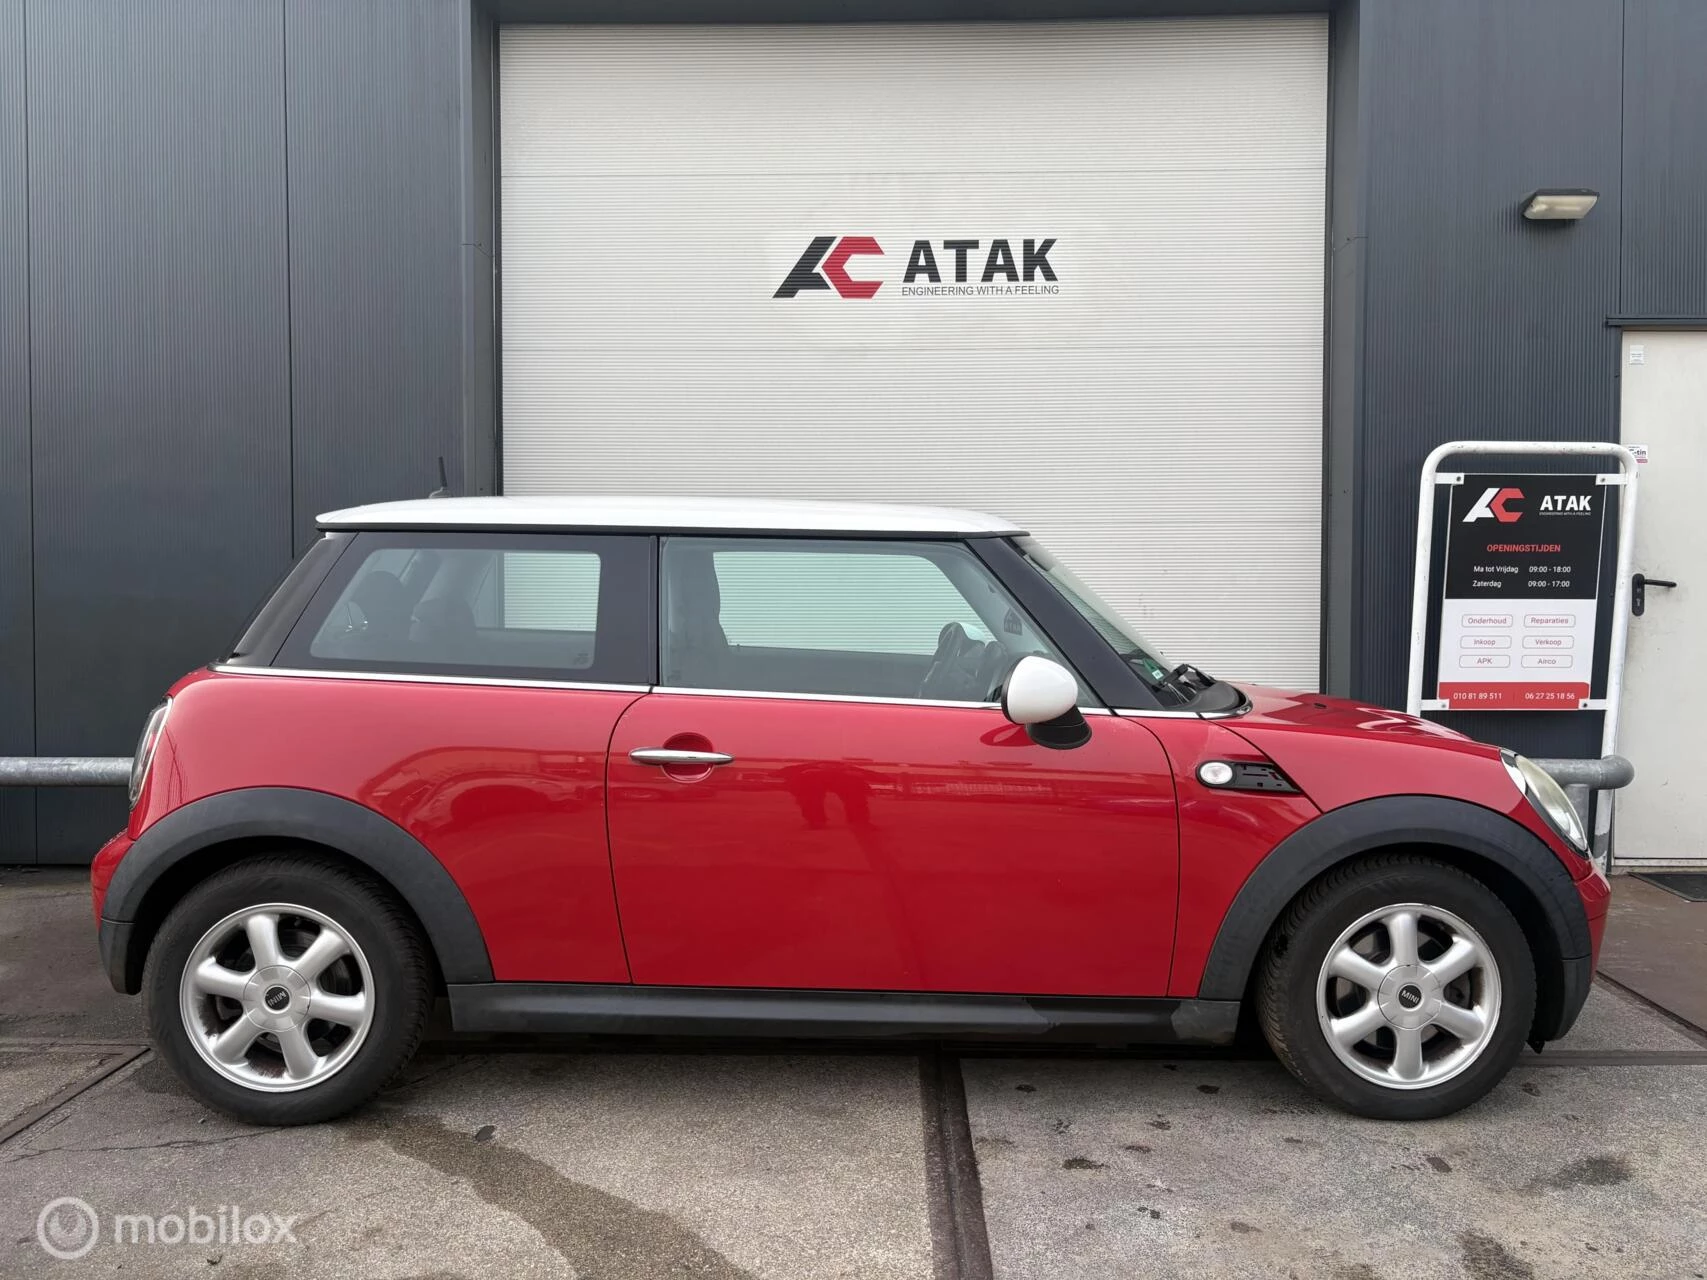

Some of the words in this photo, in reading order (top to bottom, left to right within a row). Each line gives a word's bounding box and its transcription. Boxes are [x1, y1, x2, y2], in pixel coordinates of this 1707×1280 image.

[902, 238, 1059, 283] ATAK
[901, 286, 974, 296] ENGINEERING
[976, 286, 1003, 296] WITH
[1004, 286, 1012, 295] A
[1015, 285, 1060, 295] FEELING
[1539, 495, 1592, 511] ATAK
[1486, 544, 1561, 553] OPENINGSTIJDEN
[1495, 566, 1519, 574] Vrijdag
[1472, 580, 1502, 588] Zaterdag
[1467, 617, 1507, 625] Onderhoud
[1530, 617, 1569, 626] Reparaties
[1453, 692, 1467, 700] 010
[1468, 692, 1477, 700] 81
[1478, 692, 1488, 700] 89
[1489, 692, 1502, 700] 511
[1524, 692, 1535, 700] 06
[1535, 692, 1545, 700] 27
[1545, 692, 1555, 700] 25
[1556, 692, 1565, 700] 18
[1566, 692, 1575, 700] 56
[267, 991, 287, 1007] MINI
[1401, 989, 1420, 1004] MINI
